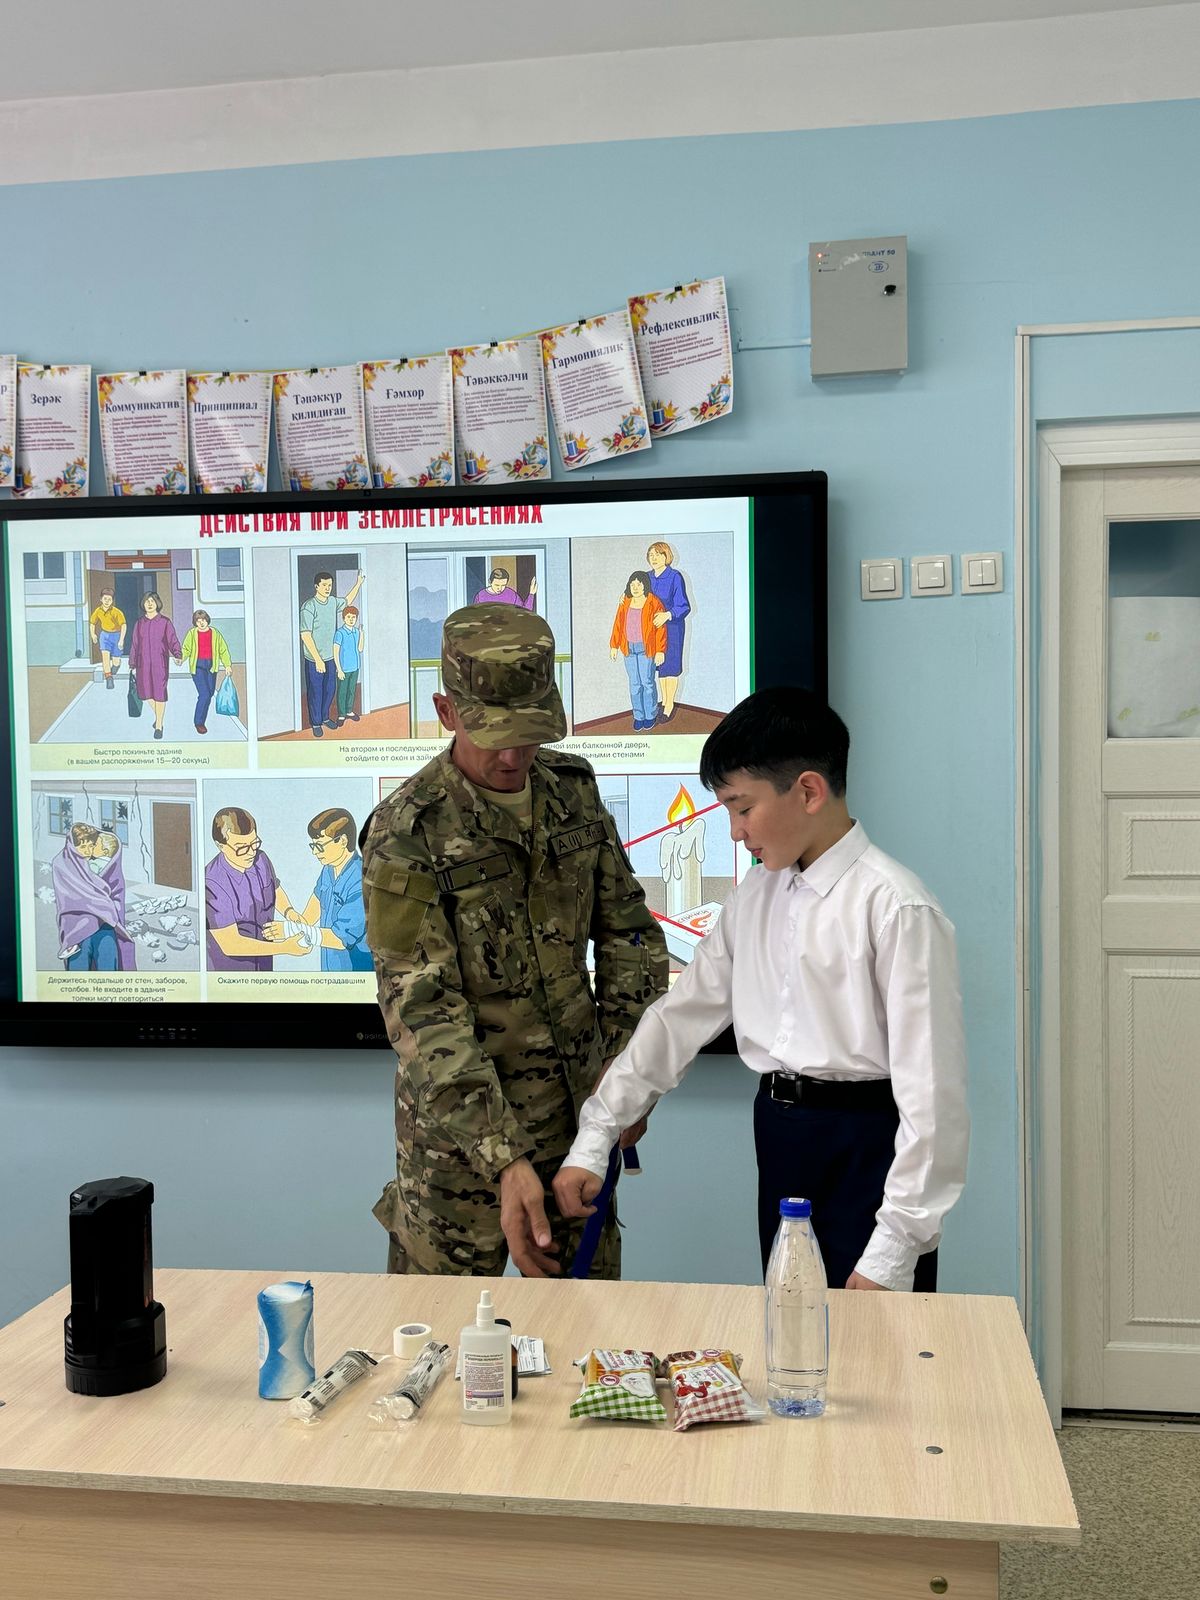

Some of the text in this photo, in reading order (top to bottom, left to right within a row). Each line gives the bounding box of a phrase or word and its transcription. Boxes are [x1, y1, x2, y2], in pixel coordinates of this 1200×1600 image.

[641, 310, 720, 336] Рефлексивлик
[551, 343, 624, 369] Гармониялик
[463, 372, 528, 387] Тәвәккәлчи
[30, 392, 62, 406] Зерәк
[386, 388, 425, 400] Ғәмхор
[105, 400, 180, 414] Коммуникатив
[193, 402, 258, 415] Принципиал
[200, 505, 543, 538] ДЕЙСТВИЯ ПРИ ЗЕМЛЕТРЯСЕНИЯХ
[93, 748, 121, 757] Быстро
[156, 748, 183, 756] здание
[339, 745, 350, 753] На
[350, 746, 378, 754] втором
[385, 745, 437, 754] последующих
[582, 741, 623, 749] балконной
[101, 758, 154, 766] распоряжении
[182, 757, 210, 765] секунд)
[612, 751, 645, 759] стенами
[47, 976, 88, 985] Держитесь
[88, 977, 124, 985] подальше
[134, 977, 154, 985] стен,
[154, 976, 188, 985] заборов,
[217, 976, 366, 986] Окажите первую помощь пострадавшим
[104, 986, 133, 994] входите
